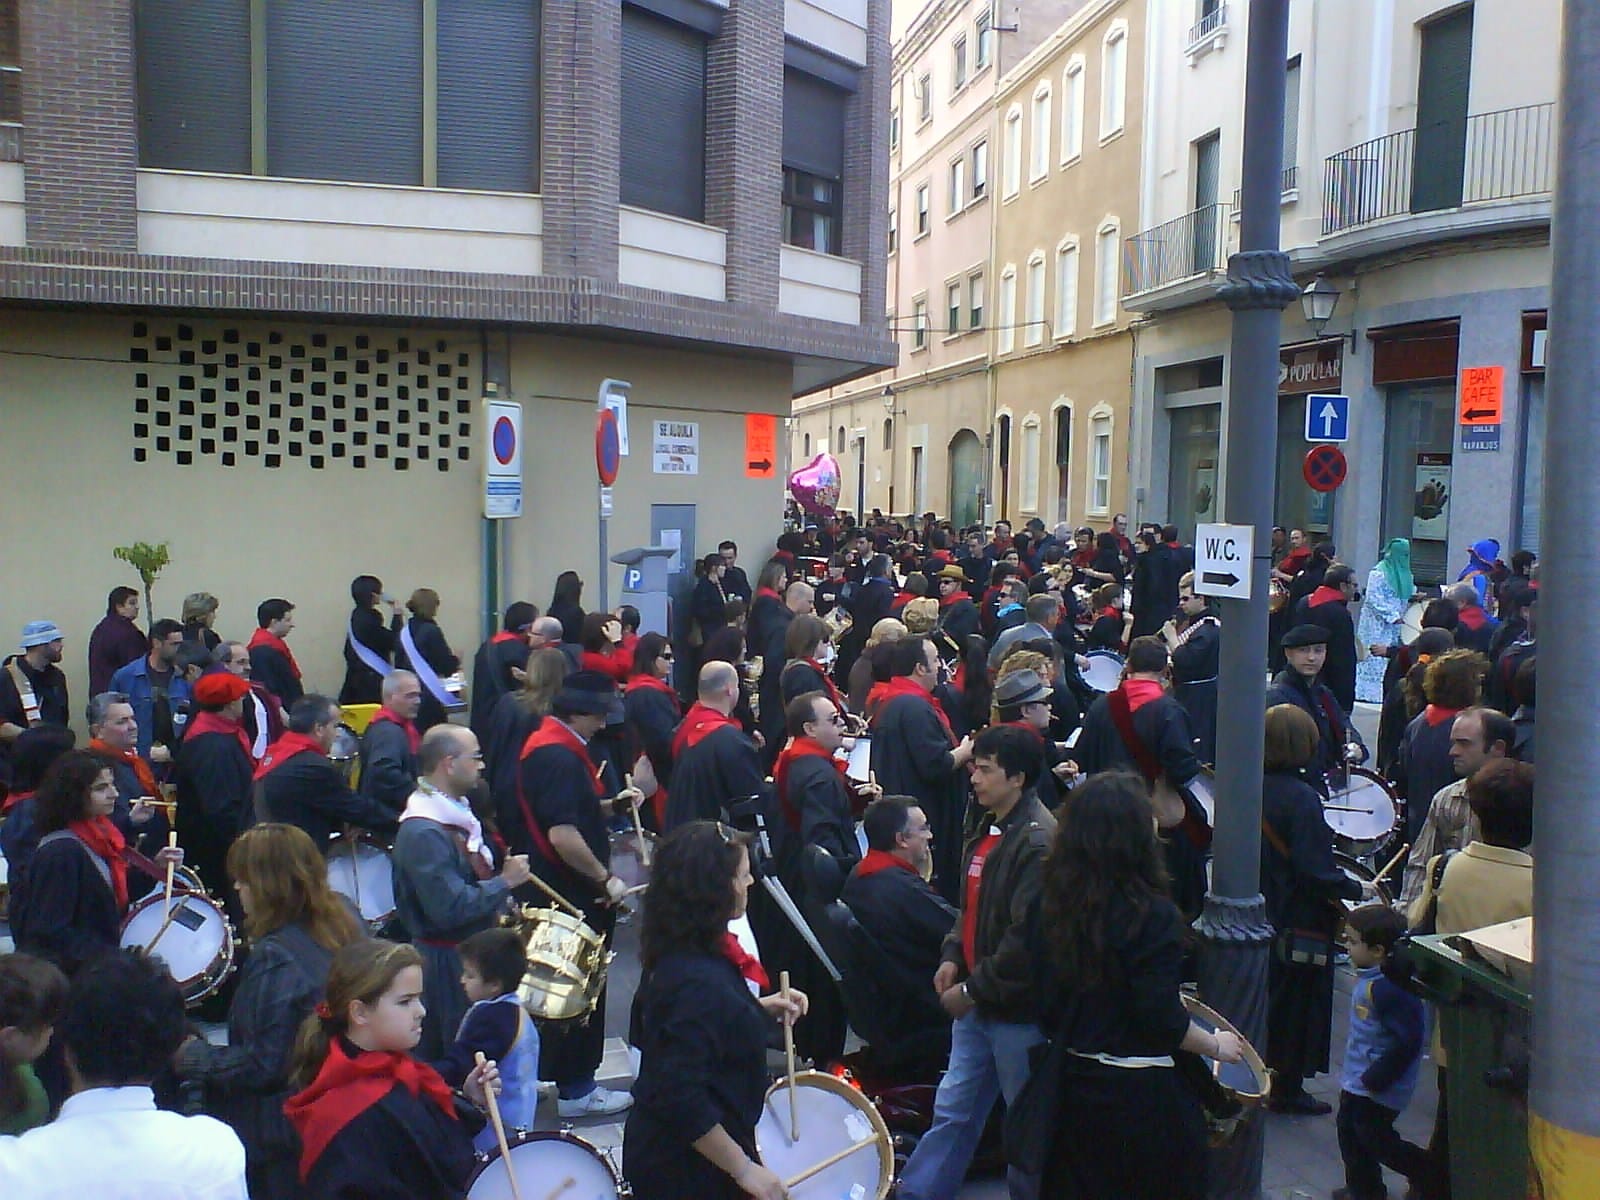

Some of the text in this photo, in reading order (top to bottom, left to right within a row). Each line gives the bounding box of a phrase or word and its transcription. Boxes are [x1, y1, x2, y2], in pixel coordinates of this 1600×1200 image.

[1290, 359, 1340, 383] POPULAR
[1469, 368, 1493, 386] BAR
[1463, 386, 1497, 404] CAFE
[1205, 537, 1241, 561] W.C.
[629, 569, 641, 588] P
